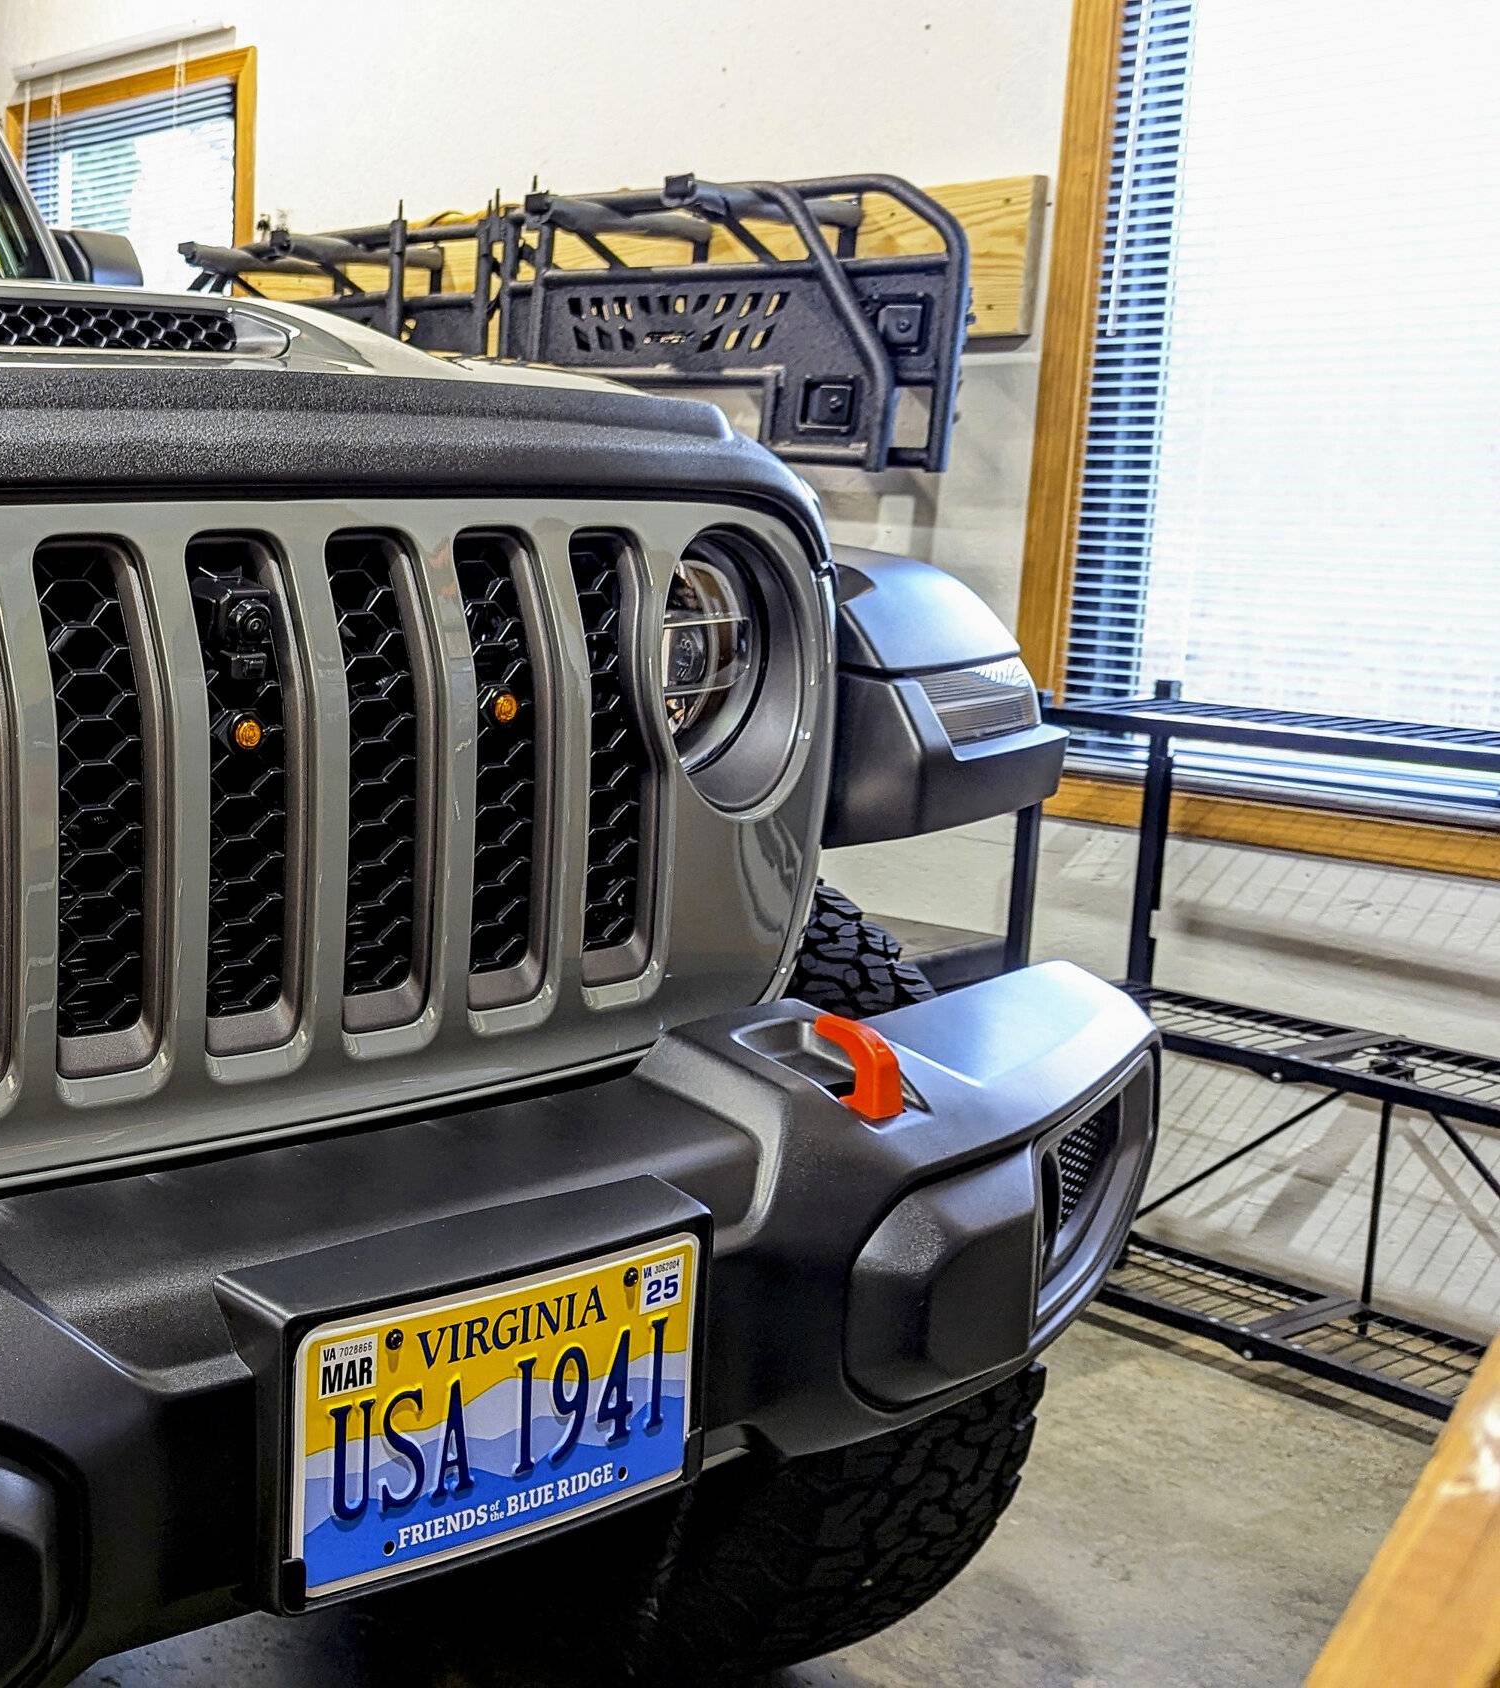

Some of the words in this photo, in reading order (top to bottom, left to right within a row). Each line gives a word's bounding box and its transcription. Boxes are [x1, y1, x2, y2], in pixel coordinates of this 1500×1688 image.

[643, 1266, 653, 1280] VA
[646, 1273, 679, 1305] 25
[416, 1285, 607, 1370] VIRGINIA
[323, 1347, 337, 1363] VA
[321, 1357, 373, 1396] MAR
[329, 1379, 474, 1520] USA
[514, 1316, 668, 1475] 1941
[556, 1462, 614, 1500] RIDGE
[489, 1499, 501, 1512] of
[489, 1510, 505, 1522] the
[506, 1482, 555, 1517] BLUE
[399, 1503, 489, 1549] FRIENDS
